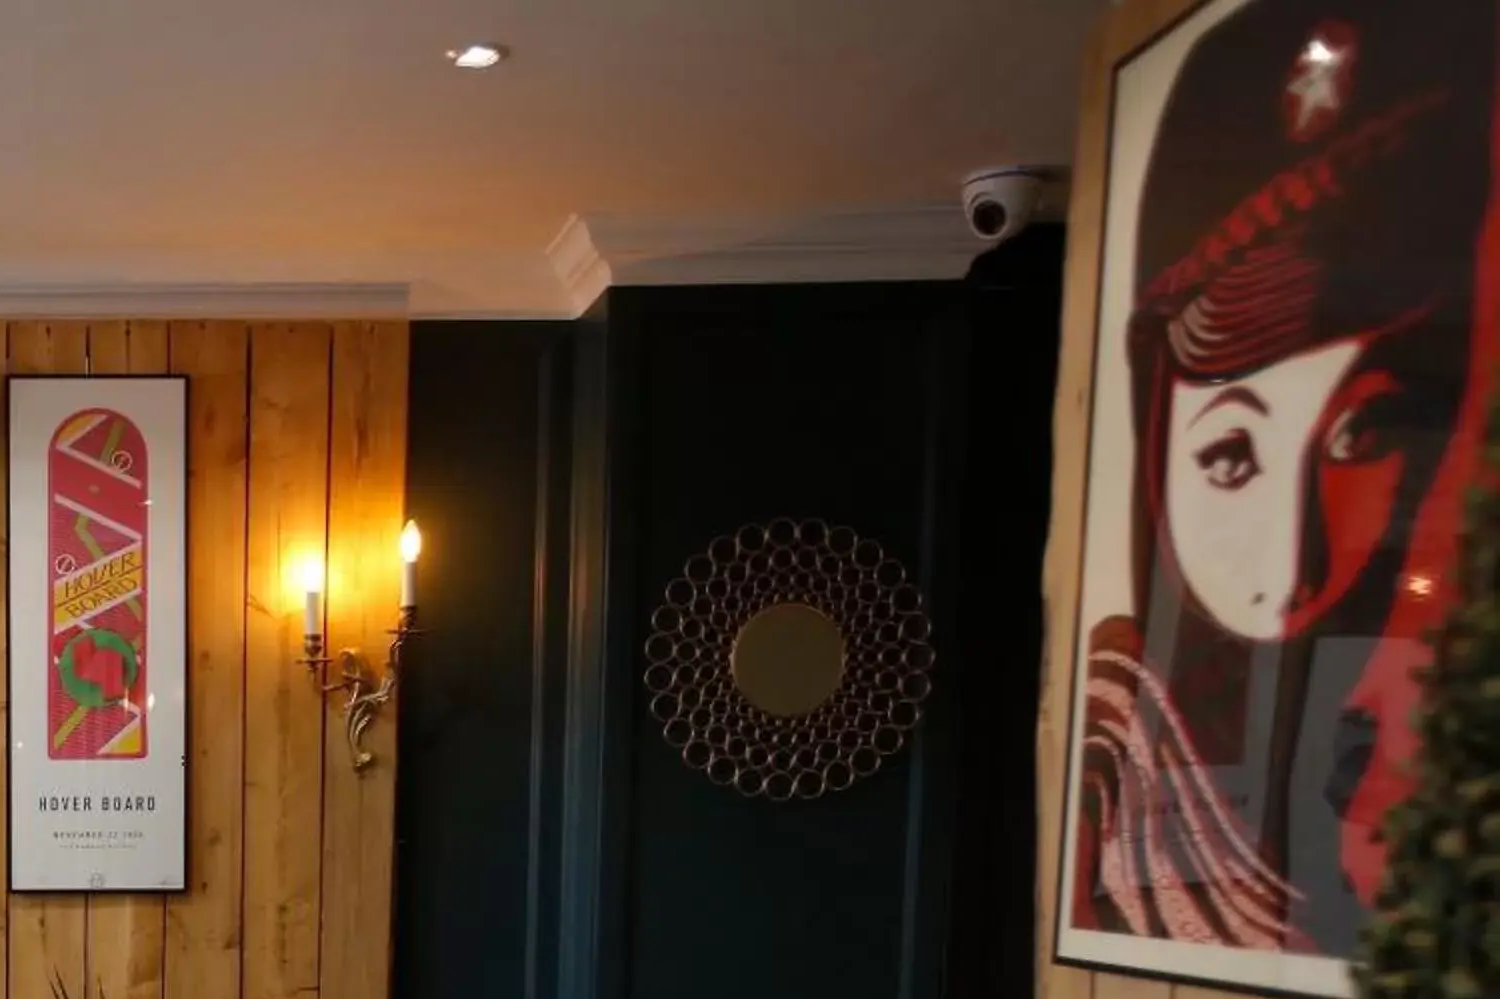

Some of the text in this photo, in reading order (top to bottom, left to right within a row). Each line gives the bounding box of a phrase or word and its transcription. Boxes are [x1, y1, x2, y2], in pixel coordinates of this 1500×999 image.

[65, 552, 135, 598] HOVER
[39, 796, 156, 811] HOVER BOARD
